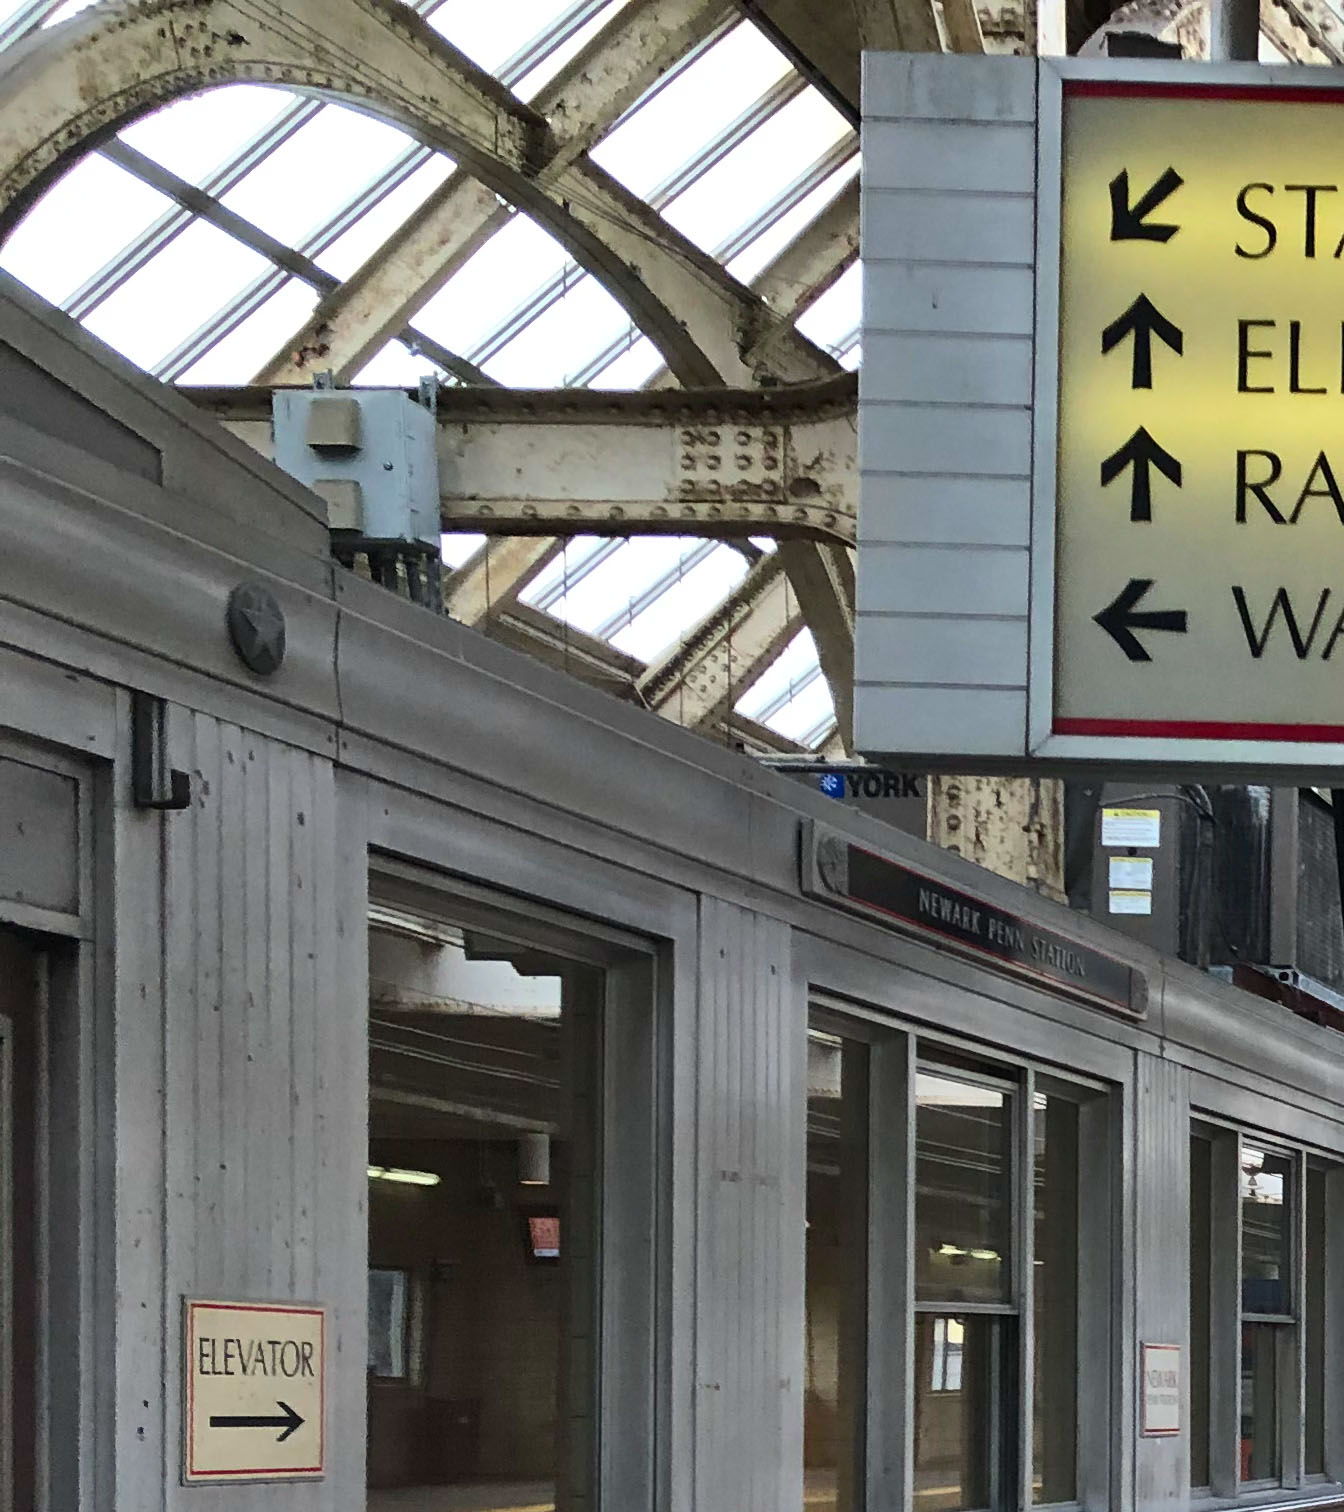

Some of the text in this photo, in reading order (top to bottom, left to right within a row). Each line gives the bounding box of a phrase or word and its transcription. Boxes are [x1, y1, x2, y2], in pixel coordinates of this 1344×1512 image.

[846, 773, 921, 798] YORK
[919, 887, 1086, 977] NEWARK PENN STATION
[199, 1337, 315, 1378] ELEVATOR
